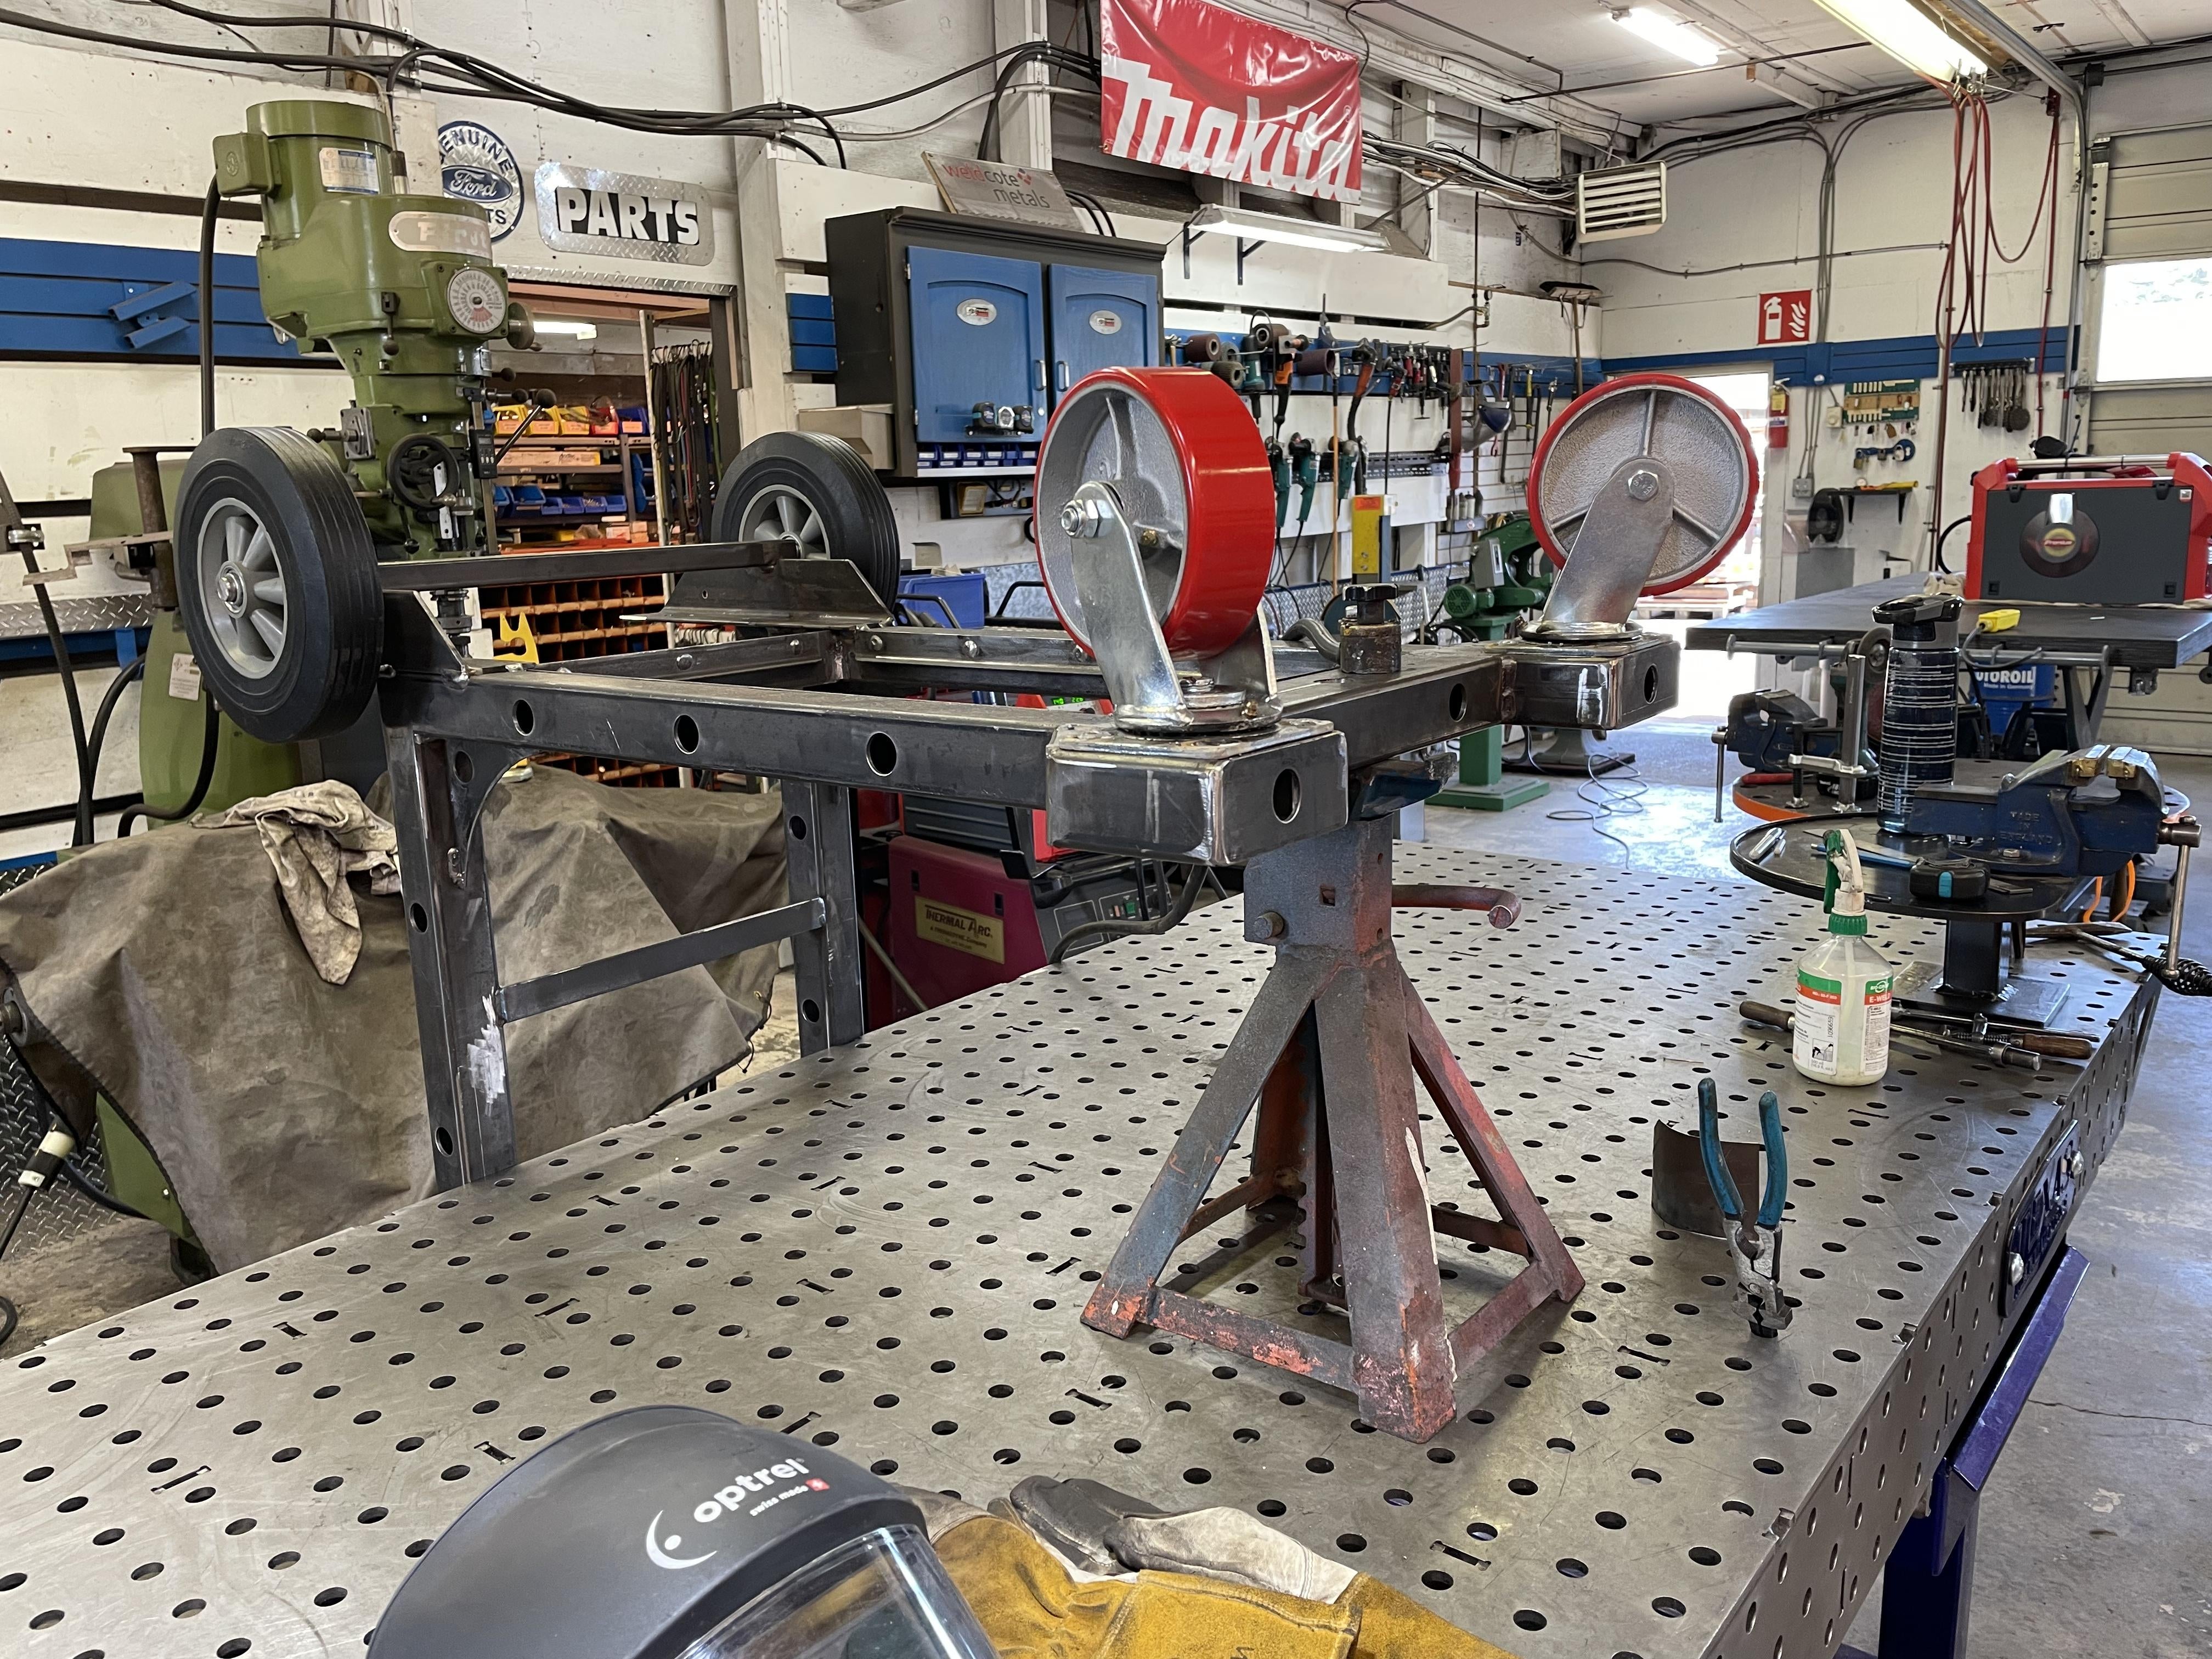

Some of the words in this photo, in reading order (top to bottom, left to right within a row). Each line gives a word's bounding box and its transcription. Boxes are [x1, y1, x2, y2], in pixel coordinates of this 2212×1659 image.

[439, 128, 514, 174] ENUINE
[450, 169, 497, 197] Ford
[941, 162, 1020, 187] weldcote
[993, 188, 1050, 208] metals
[556, 187, 699, 245] PARTS
[1975, 670, 2034, 684] OTOROIL
[925, 905, 966, 930] THERMAL
[693, 1458, 810, 1523] optrel
[749, 1497, 779, 1516] swiss
[778, 1485, 809, 1500] made
